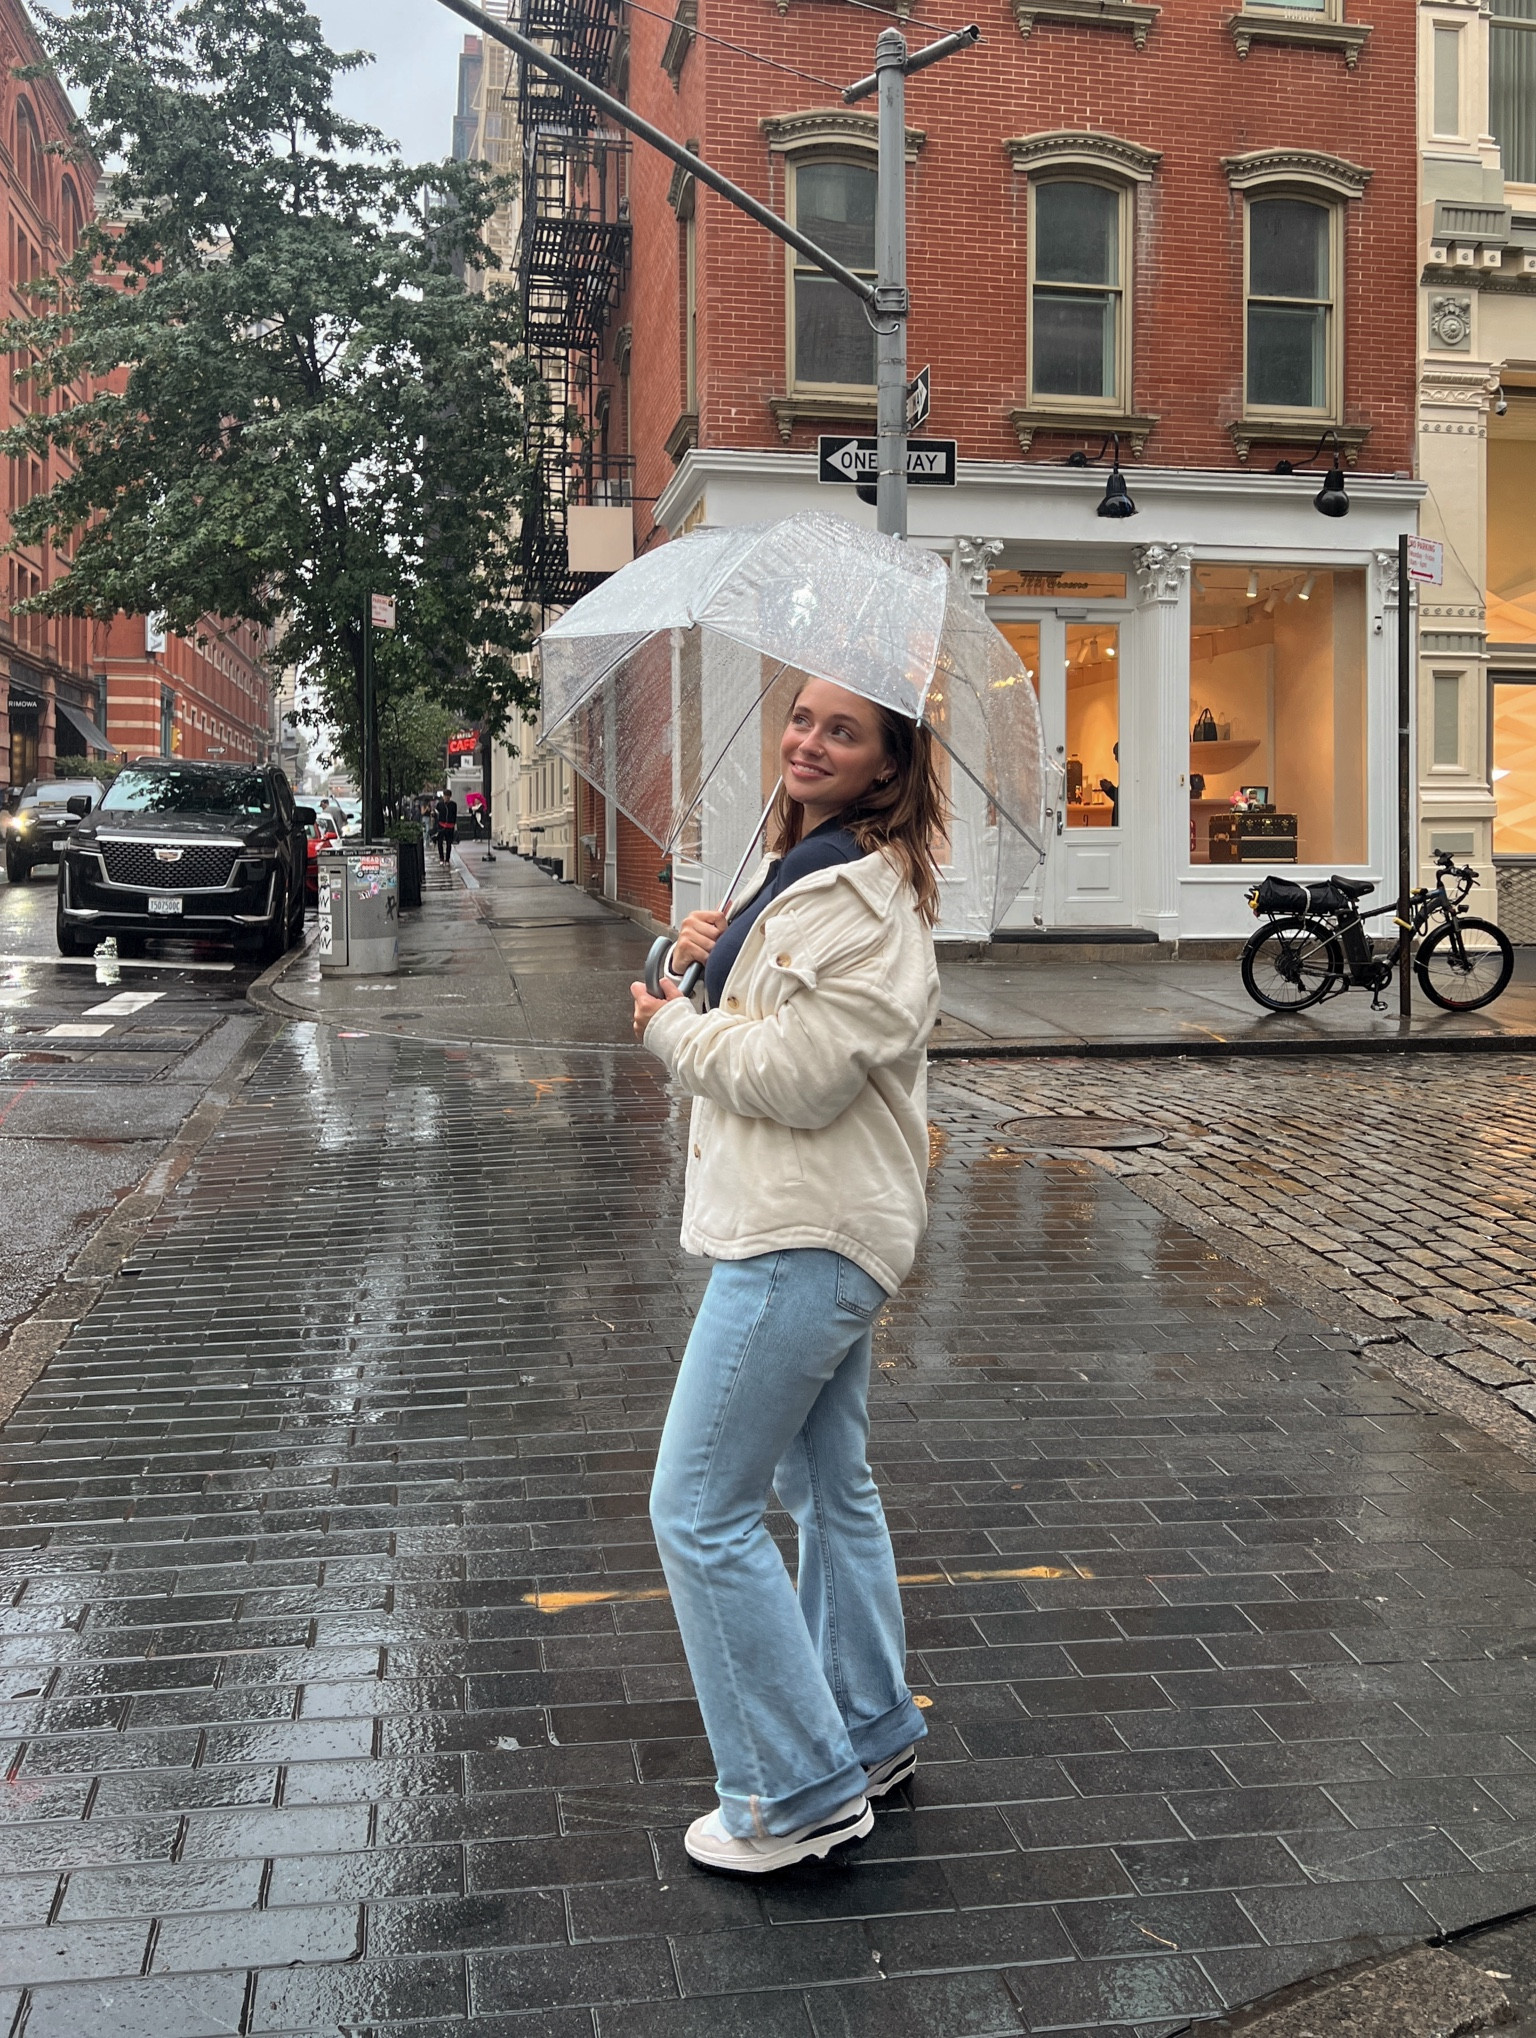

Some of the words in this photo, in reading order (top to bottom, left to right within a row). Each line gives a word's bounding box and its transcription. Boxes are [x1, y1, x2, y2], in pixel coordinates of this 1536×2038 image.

[841, 451, 877, 469] ONE
[8, 700, 37, 708] RIMOWA
[450, 738, 476, 752] CAFE
